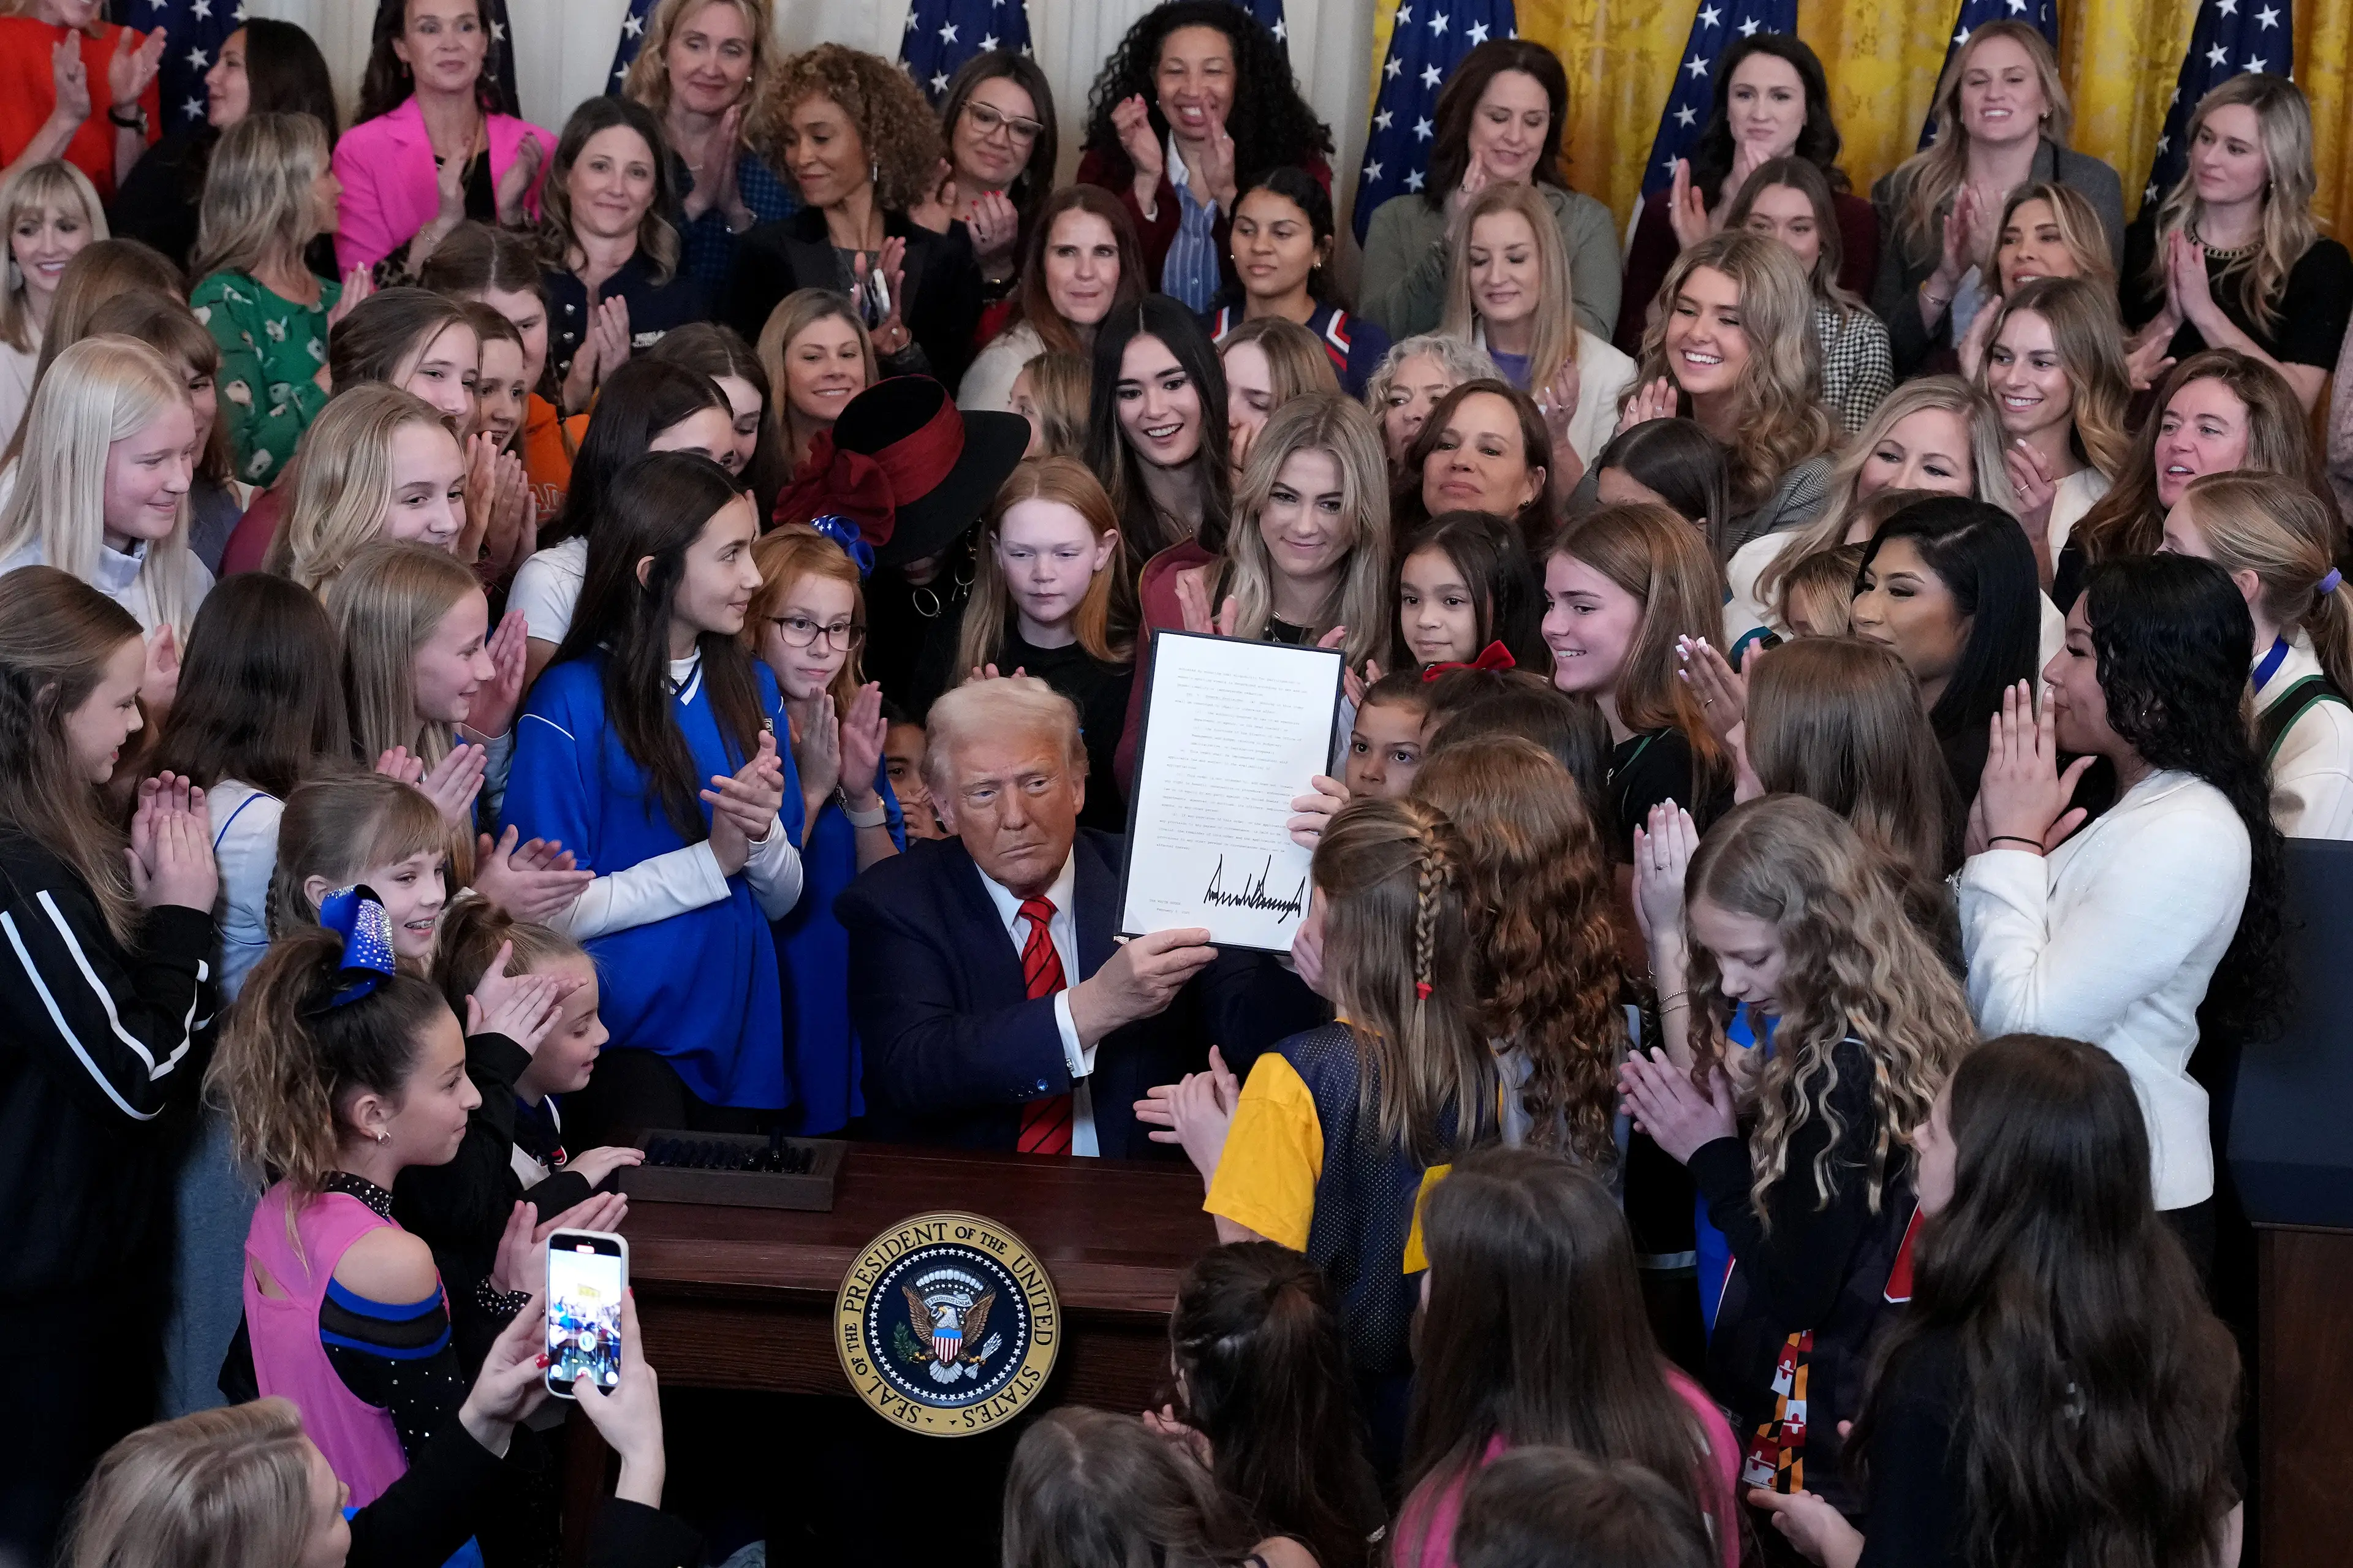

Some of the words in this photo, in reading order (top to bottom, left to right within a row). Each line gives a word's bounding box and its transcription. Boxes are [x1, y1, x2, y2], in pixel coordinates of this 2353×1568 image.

[955, 1225, 976, 1240] OF
[979, 1232, 1008, 1255] THE
[843, 1222, 948, 1314] PRESIDENT
[1011, 1254, 1054, 1346] UNITED
[846, 1322, 860, 1353] THE
[852, 1357, 868, 1376] OF
[866, 1374, 922, 1424] SEAL
[962, 1365, 1040, 1428] STATES
